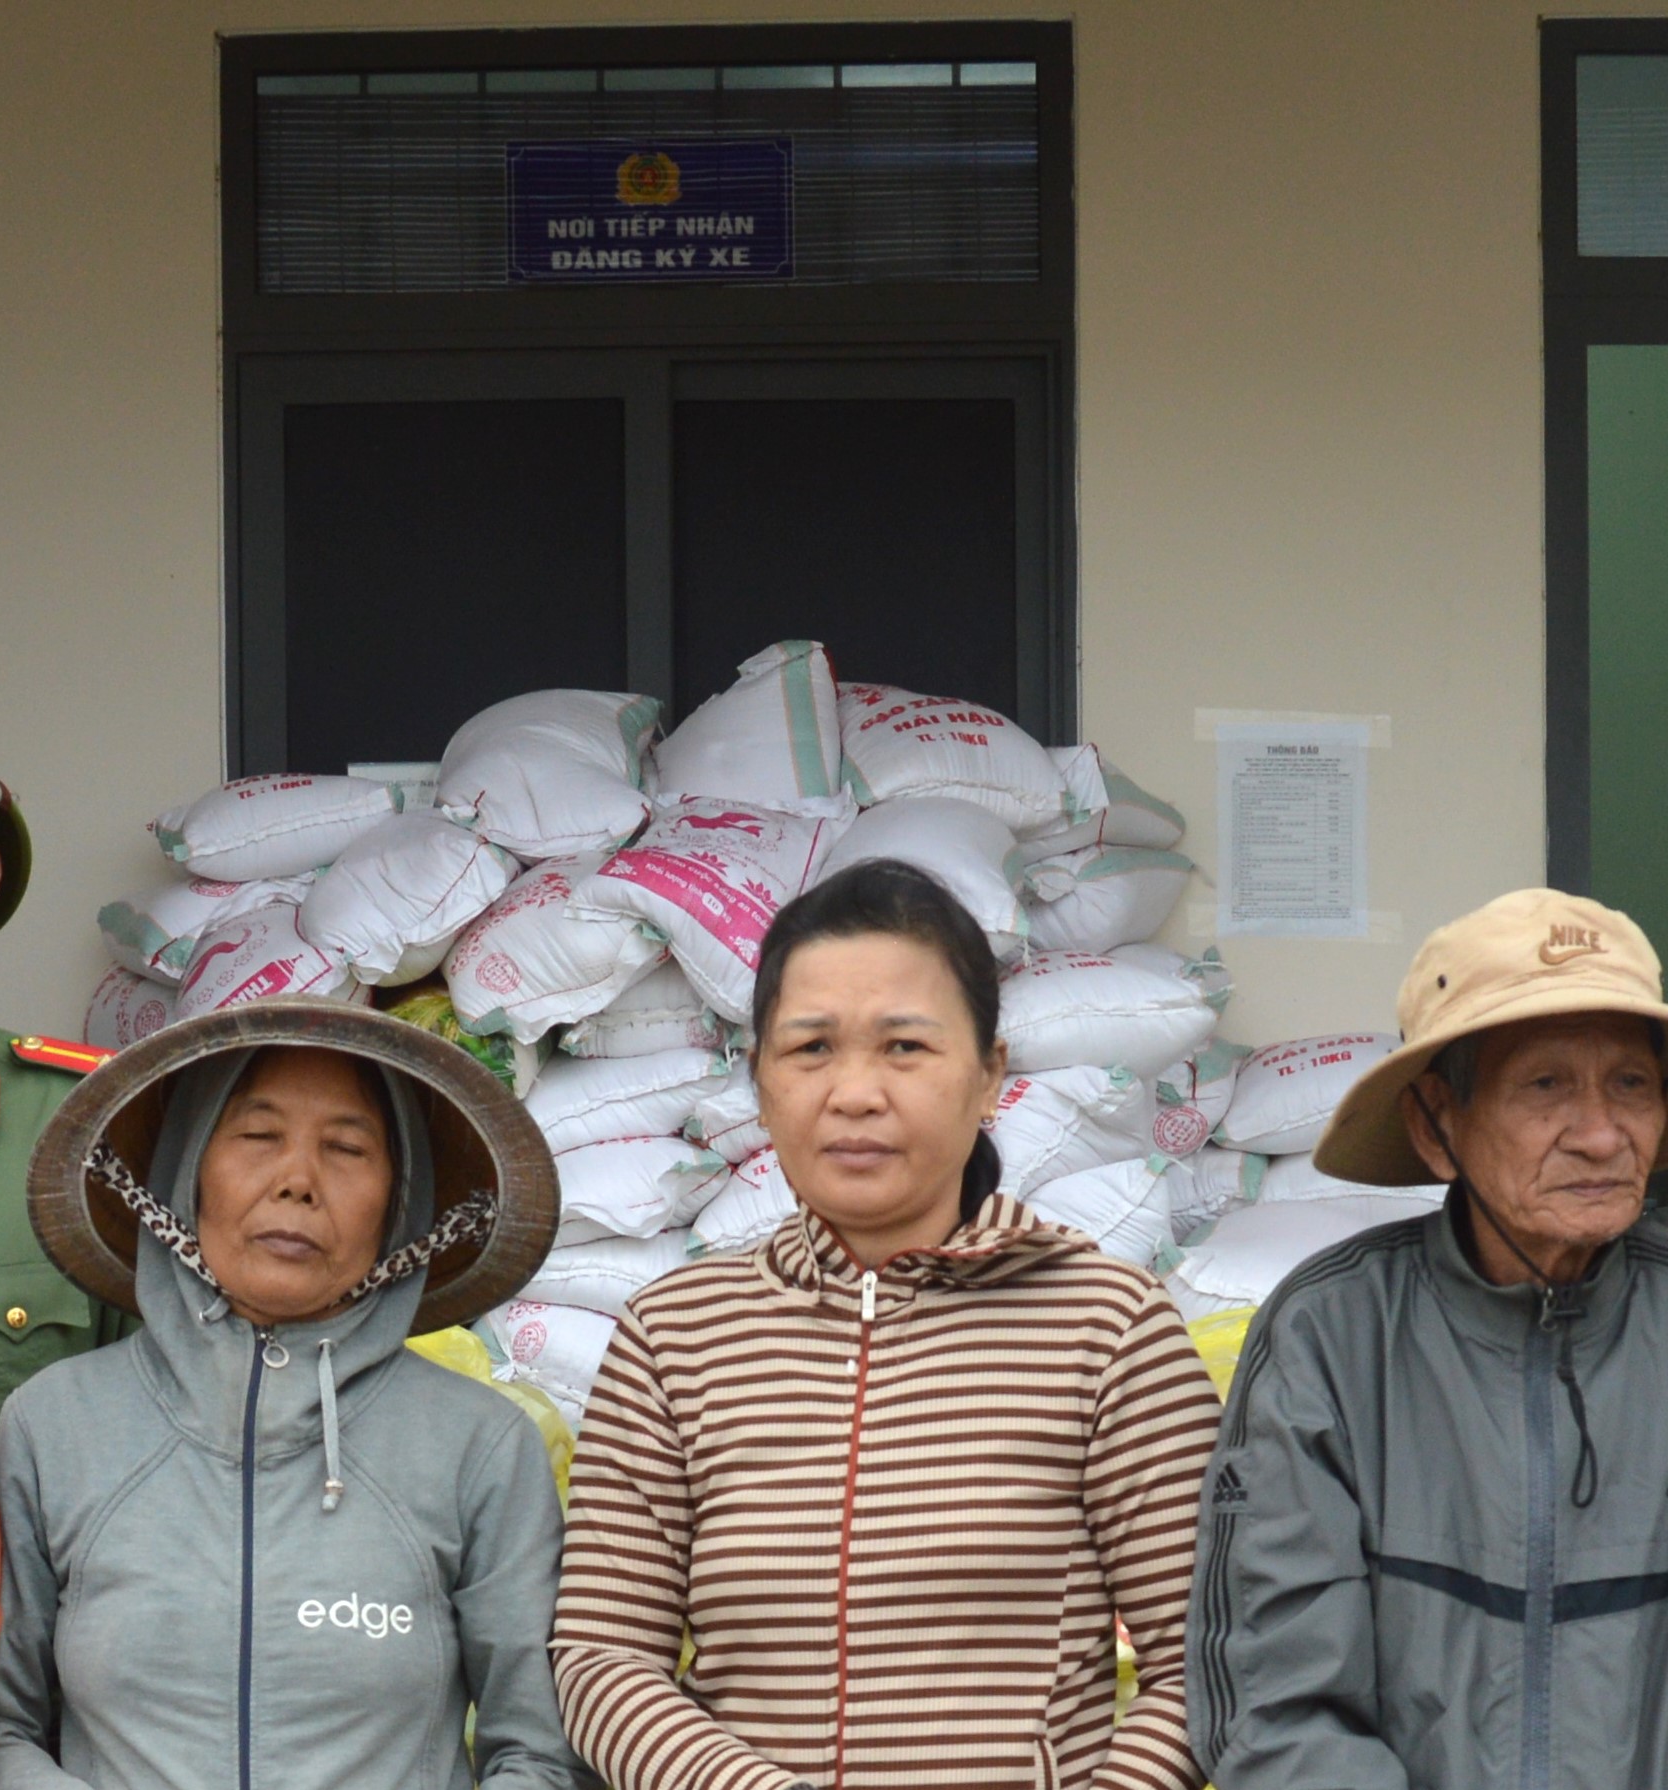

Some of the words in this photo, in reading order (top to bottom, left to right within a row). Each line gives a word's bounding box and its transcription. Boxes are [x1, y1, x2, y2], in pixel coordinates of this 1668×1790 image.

[548, 216, 595, 239] NƠI
[604, 211, 665, 238] TIẾP
[676, 212, 754, 240] NHẬN
[551, 246, 643, 270] ĐĂNG
[655, 244, 696, 268] KÝ
[709, 248, 751, 267] XE
[860, 705, 906, 731] GẠO
[893, 715, 941, 733] HẢI
[946, 711, 1005, 727] HẬU
[916, 733, 936, 742] TL
[948, 731, 989, 747] 10KG
[237, 790, 256, 800] TL
[271, 779, 313, 792] 10KG
[1549, 924, 1603, 951] NIKE
[1277, 1065, 1295, 1077] TL
[1310, 1051, 1352, 1068] 10KG
[297, 1592, 413, 1639] edge
